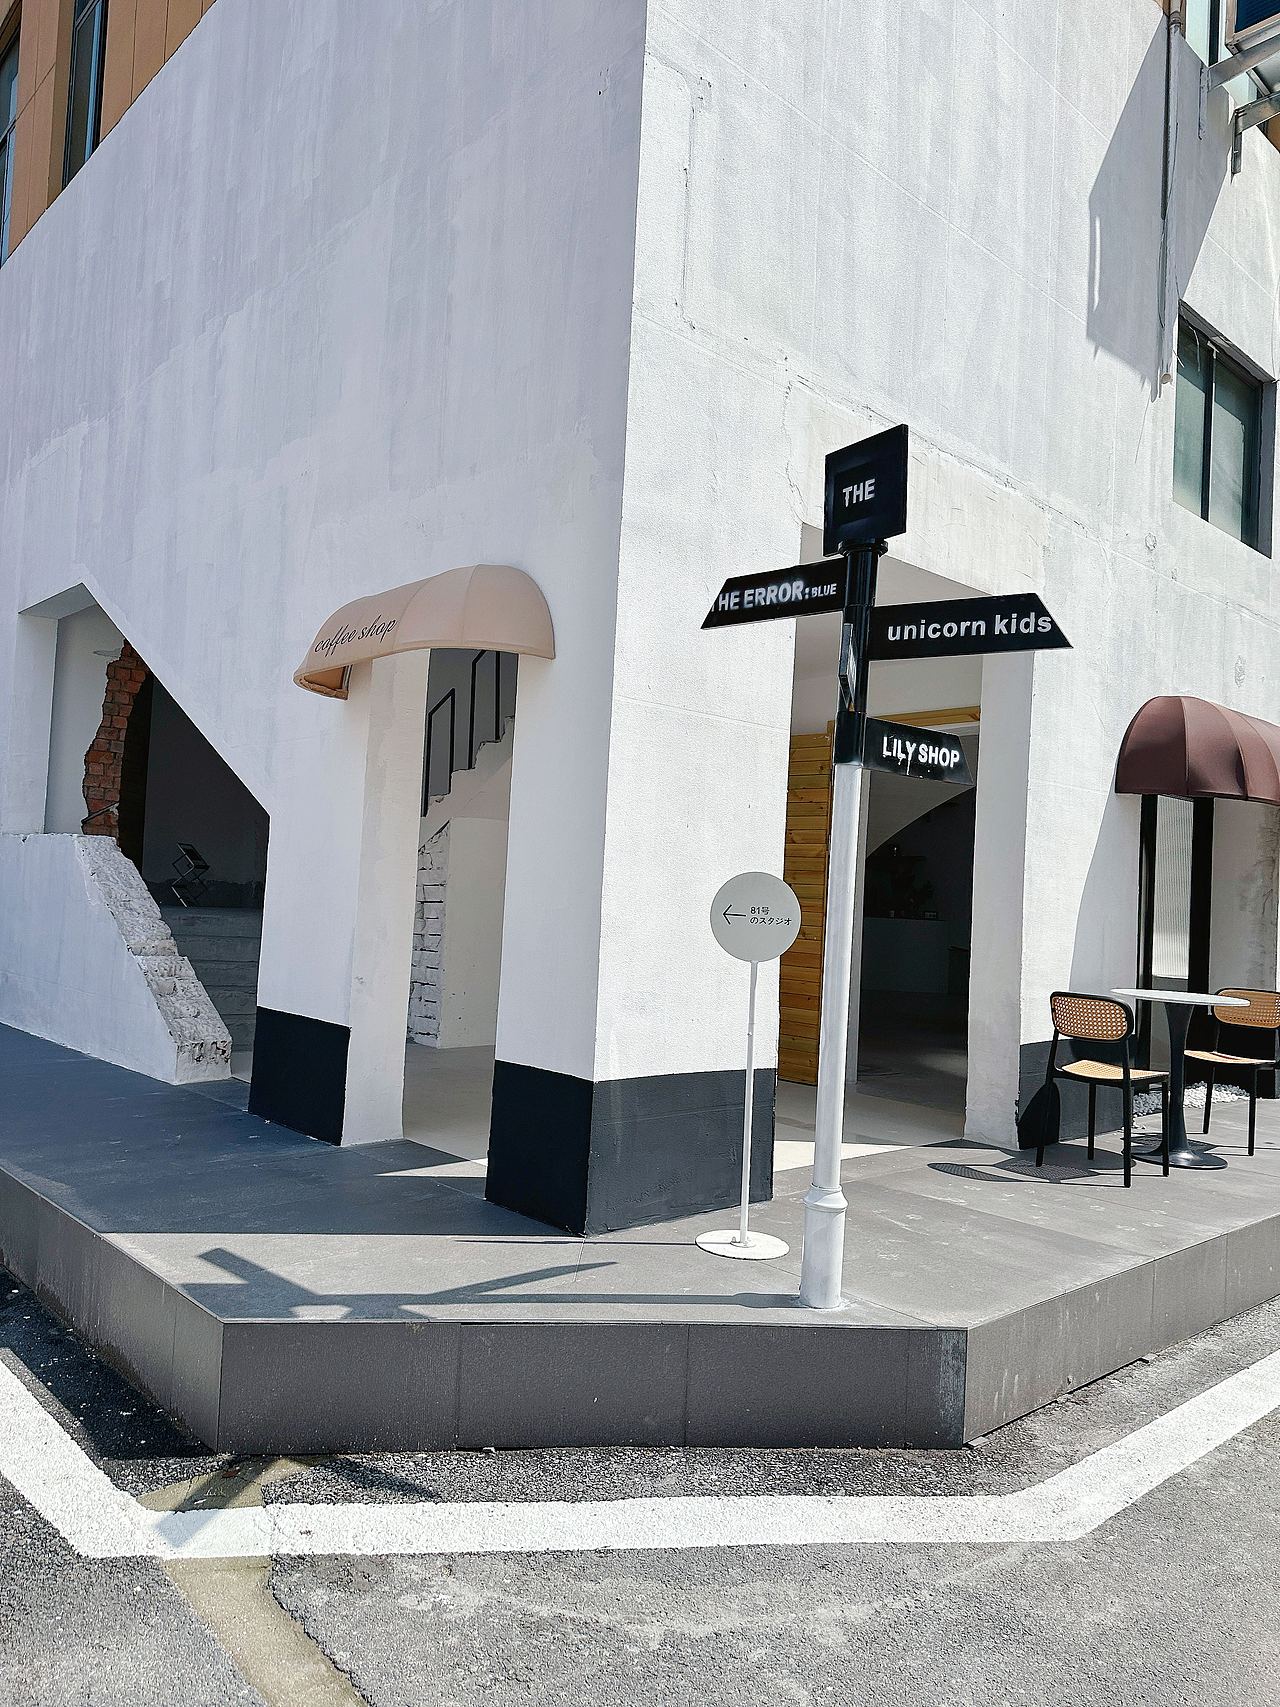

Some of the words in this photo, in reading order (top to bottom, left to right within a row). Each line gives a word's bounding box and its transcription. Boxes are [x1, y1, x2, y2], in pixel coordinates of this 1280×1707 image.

[842, 478, 876, 508] THE
[314, 623, 357, 658] coffee
[357, 614, 396, 643] shop
[887, 619, 986, 641] unicorn
[994, 612, 1052, 635] kids
[882, 736, 917, 763] LILY
[917, 743, 960, 768] SHOP
[749, 916, 792, 926] のスタジオ
[750, 906, 770, 915] 81号
